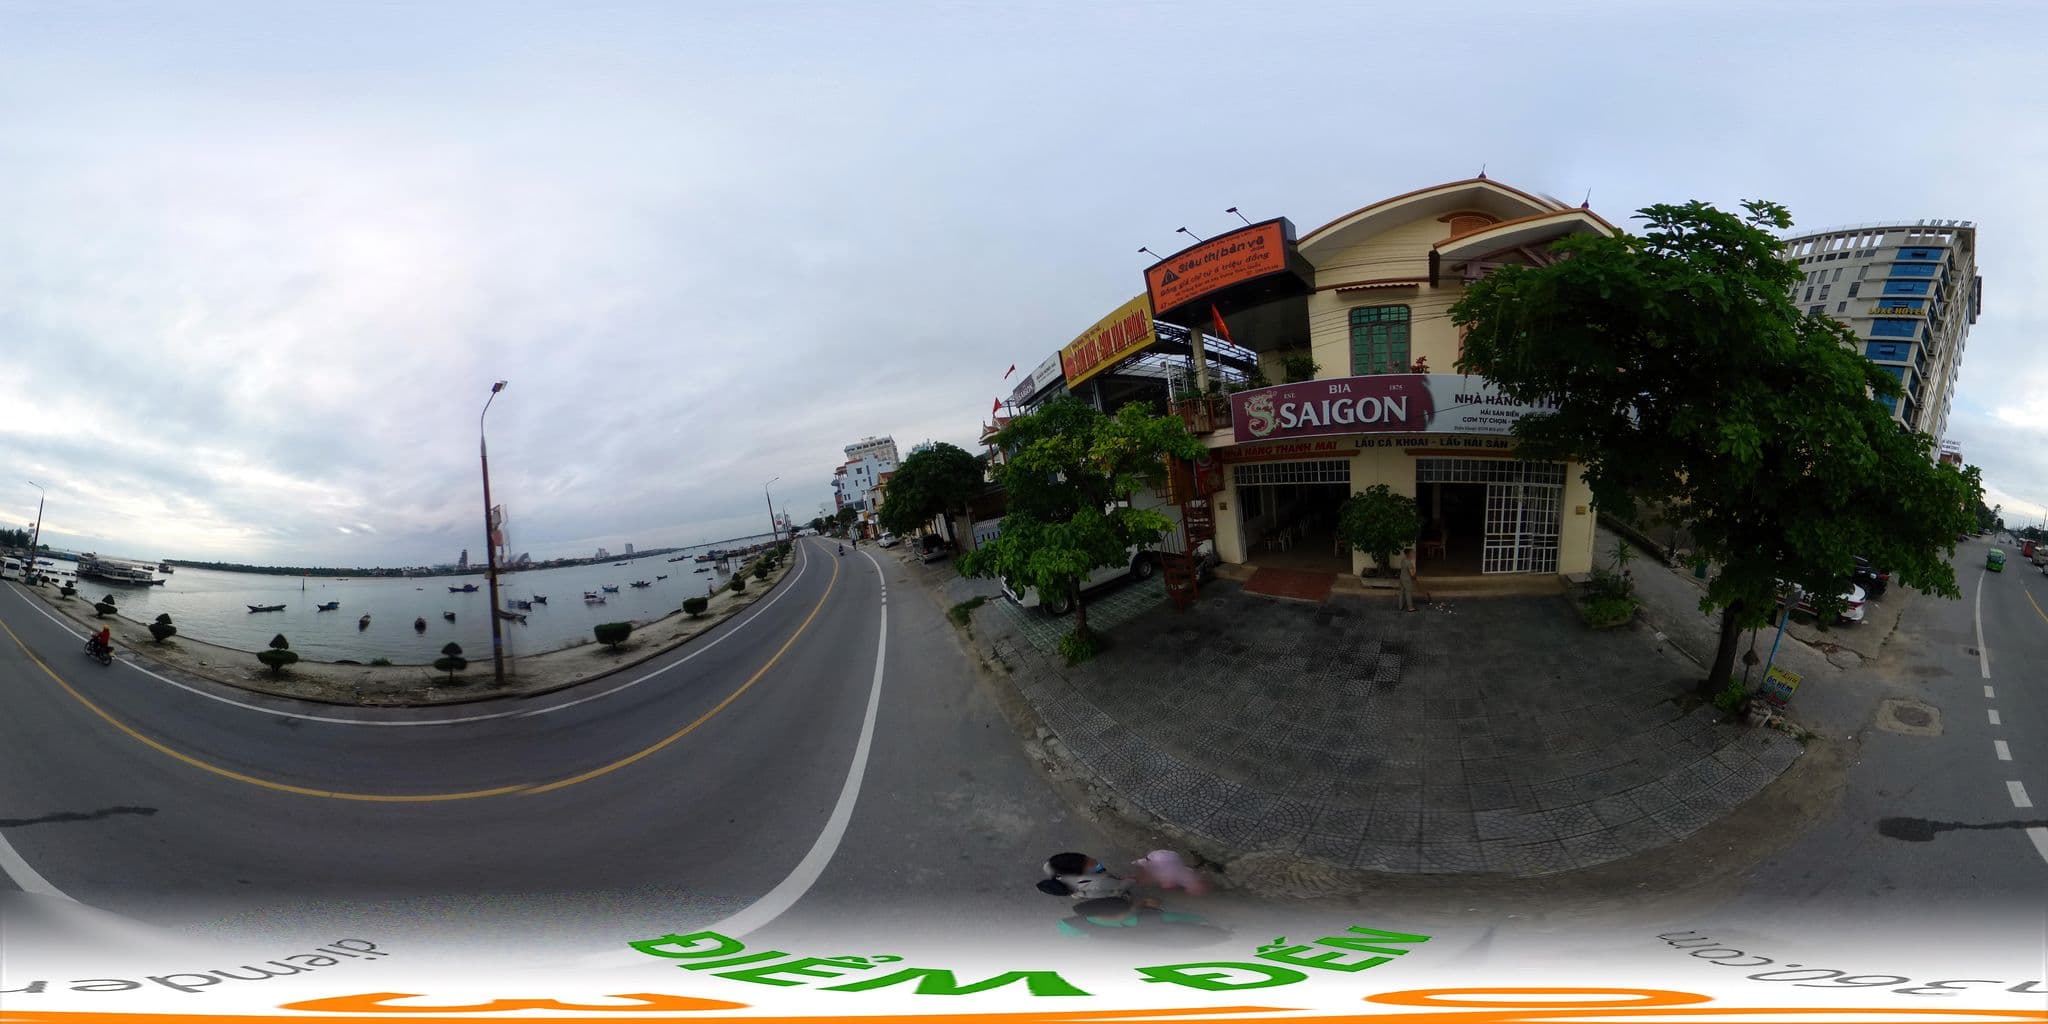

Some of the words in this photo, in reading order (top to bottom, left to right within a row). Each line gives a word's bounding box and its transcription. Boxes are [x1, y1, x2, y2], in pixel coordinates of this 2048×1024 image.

[1329, 384, 1351, 394] BIA
[1454, 392, 1482, 405] NHÀ
[1279, 395, 1408, 428] SAIGON
[1276, 443, 1312, 455] THANH
[1315, 440, 1338, 451] MAI
[1396, 438, 1428, 447] KHOAI
